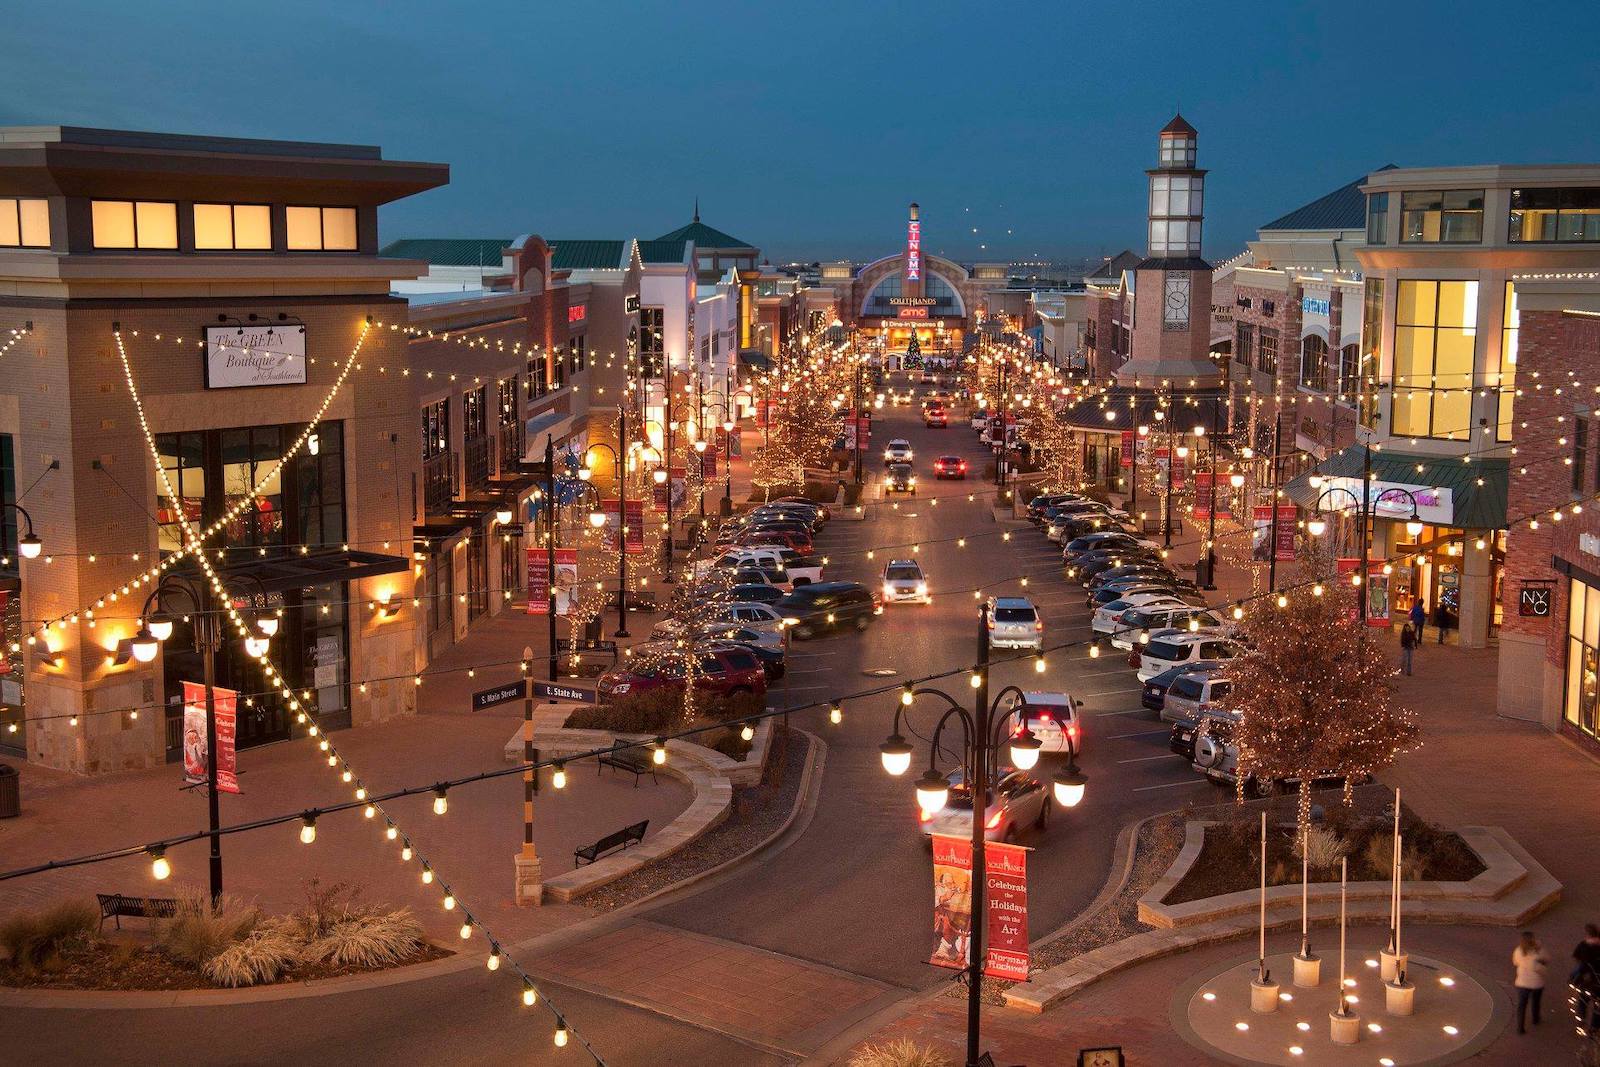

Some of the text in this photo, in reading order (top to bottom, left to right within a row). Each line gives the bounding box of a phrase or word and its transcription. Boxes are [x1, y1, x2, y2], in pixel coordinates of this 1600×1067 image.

[909, 223, 919, 278] CINEMA
[889, 297, 937, 306] SOUTHLANDS
[215, 333, 286, 347] The GREEN
[226, 354, 275, 370] Boutique
[481, 688, 517, 704] S. Main Street
[546, 686, 583, 699] E. State Ave
[990, 899, 1027, 914] Holidays
[1001, 924, 1018, 935] Art
[990, 951, 1027, 966] Norman
